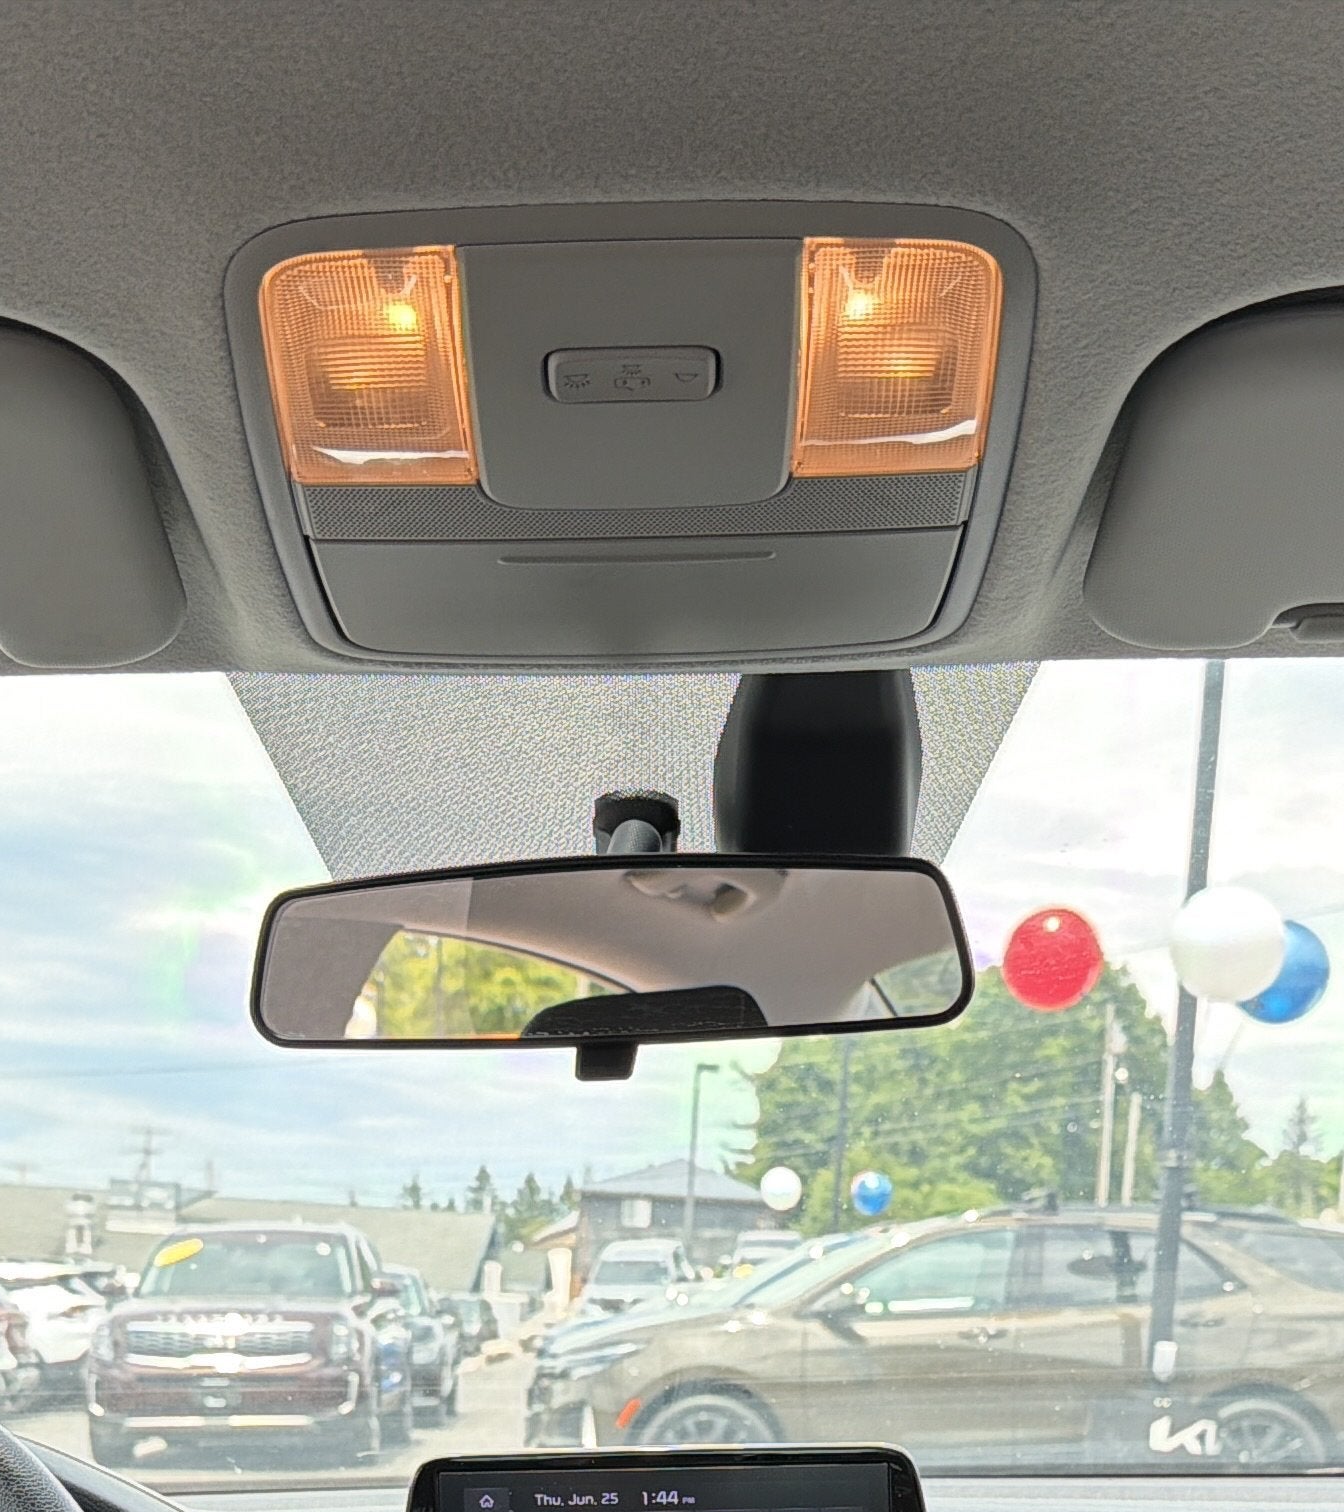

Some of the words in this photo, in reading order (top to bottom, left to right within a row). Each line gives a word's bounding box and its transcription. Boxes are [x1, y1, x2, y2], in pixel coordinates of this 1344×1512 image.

[568, 1493, 598, 1506] Jun.
[601, 1492, 619, 1505] 25
[642, 1490, 679, 1506] 1:44
